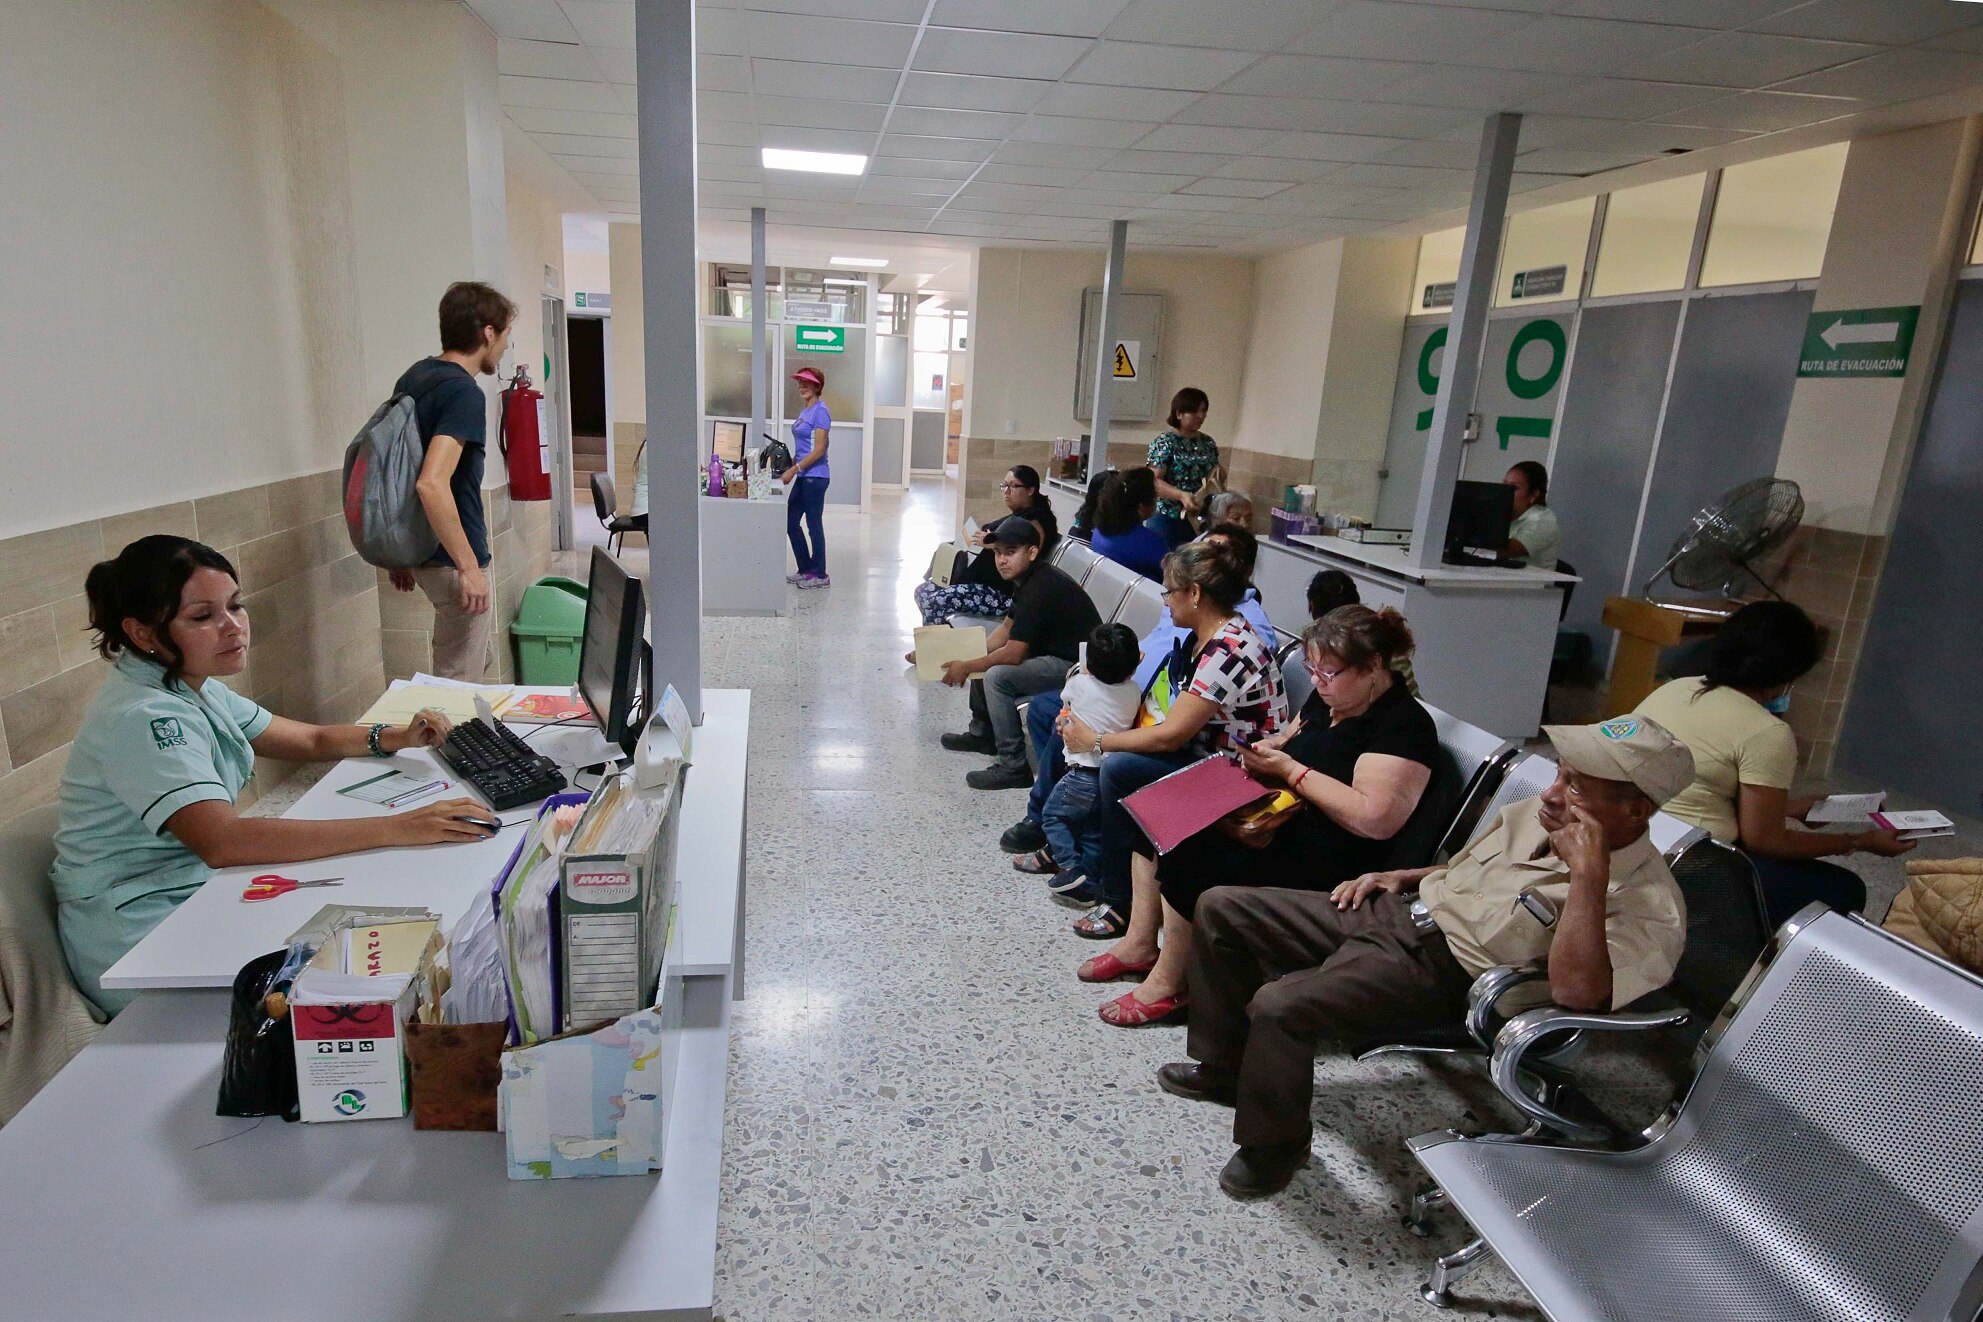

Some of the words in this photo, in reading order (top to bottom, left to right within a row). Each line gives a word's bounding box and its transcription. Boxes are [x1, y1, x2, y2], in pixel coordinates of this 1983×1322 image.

[1801, 360, 1824, 371] RUTA
[1826, 360, 1840, 371] DE
[1841, 357, 1905, 371] EVACUACIÓN
[1496, 319, 1567, 451] 10
[157, 737, 188, 751] IMSS
[577, 875, 627, 885] MAJOR
